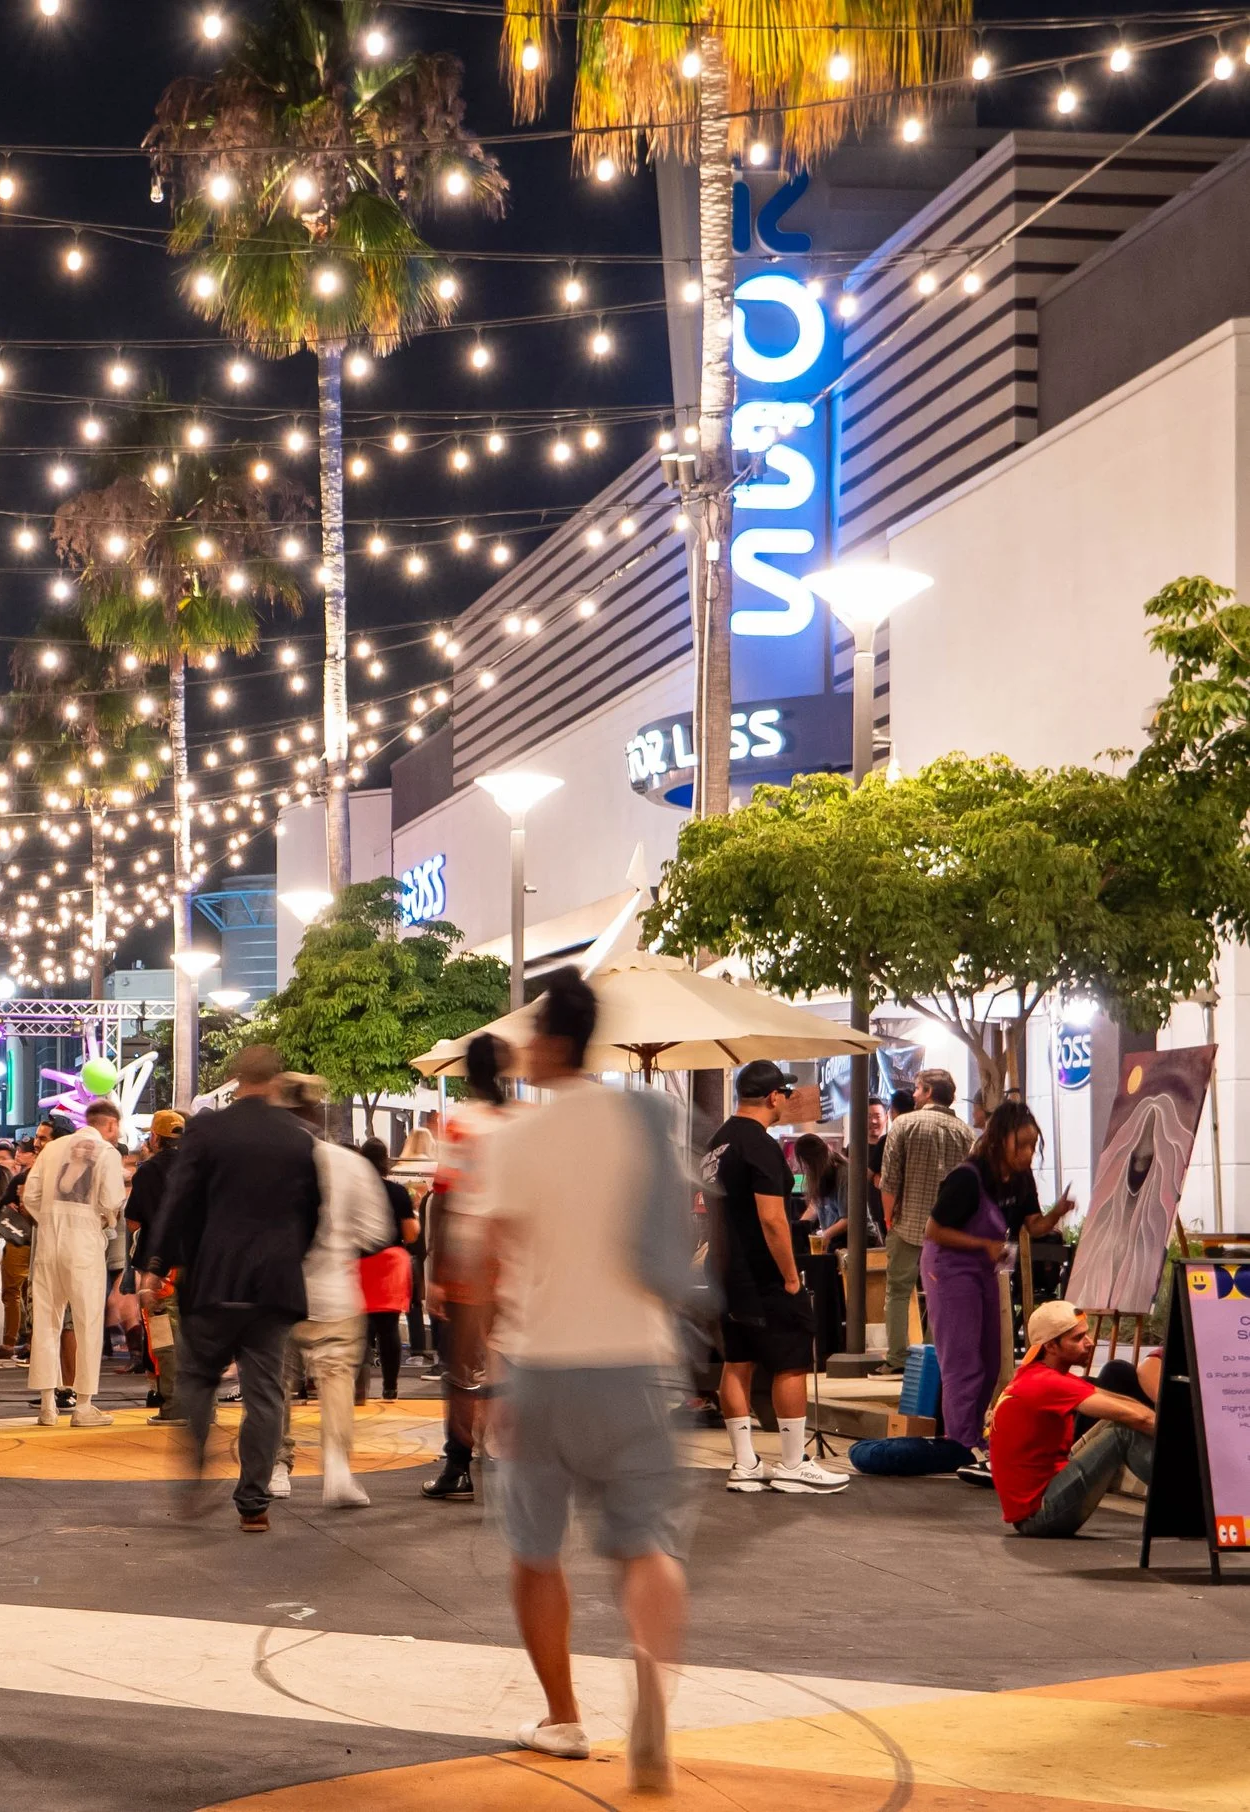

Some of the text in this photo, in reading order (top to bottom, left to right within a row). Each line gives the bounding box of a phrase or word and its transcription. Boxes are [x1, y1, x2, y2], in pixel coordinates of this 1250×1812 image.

[671, 708, 784, 769] LSS
[401, 853, 447, 929] ROSS
[799, 1471, 823, 1480] HOKA
